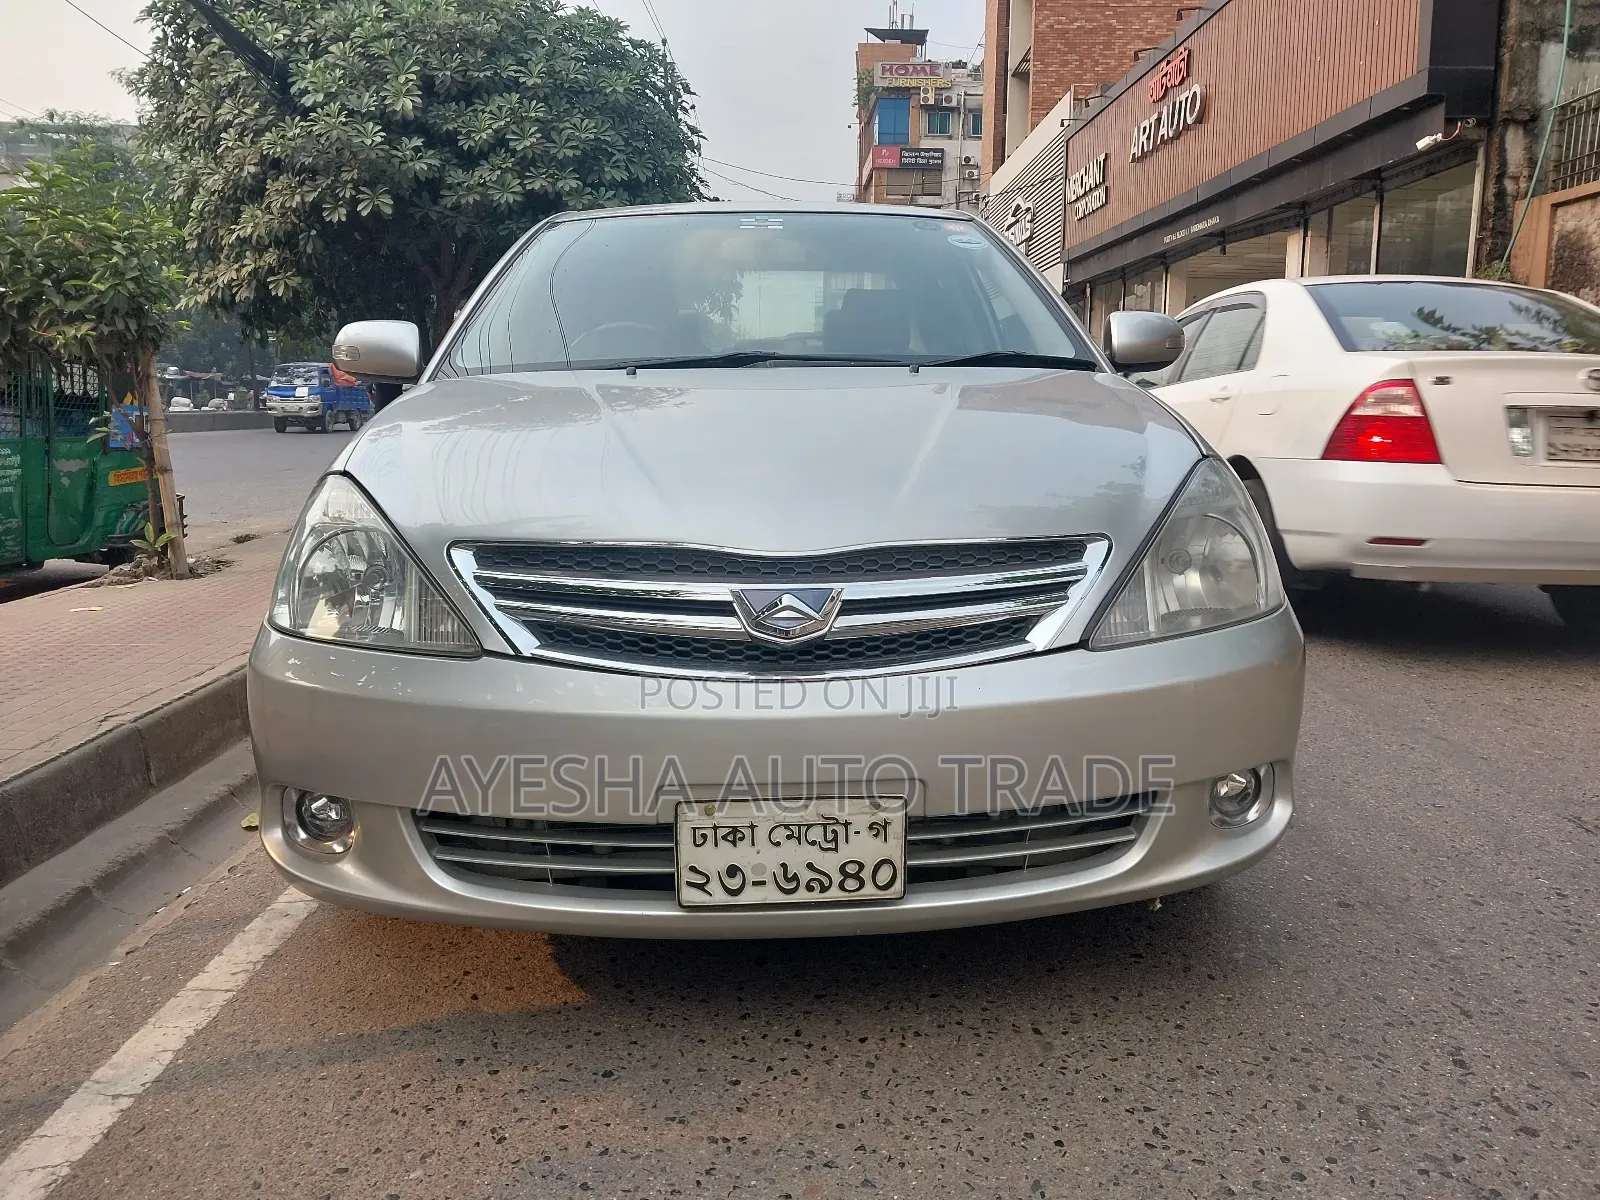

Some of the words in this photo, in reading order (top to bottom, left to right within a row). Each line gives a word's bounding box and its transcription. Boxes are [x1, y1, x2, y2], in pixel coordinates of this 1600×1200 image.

[881, 64, 941, 77] HOME
[886, 77, 952, 88] FURNISHERS
[1129, 111, 1161, 163] ART
[1157, 83, 1204, 145] AUTO
[1065, 152, 1107, 205] MERCHANT
[690, 819, 759, 849] ঢাকা
[684, 857, 899, 898] ২৩-৬৯৪০
